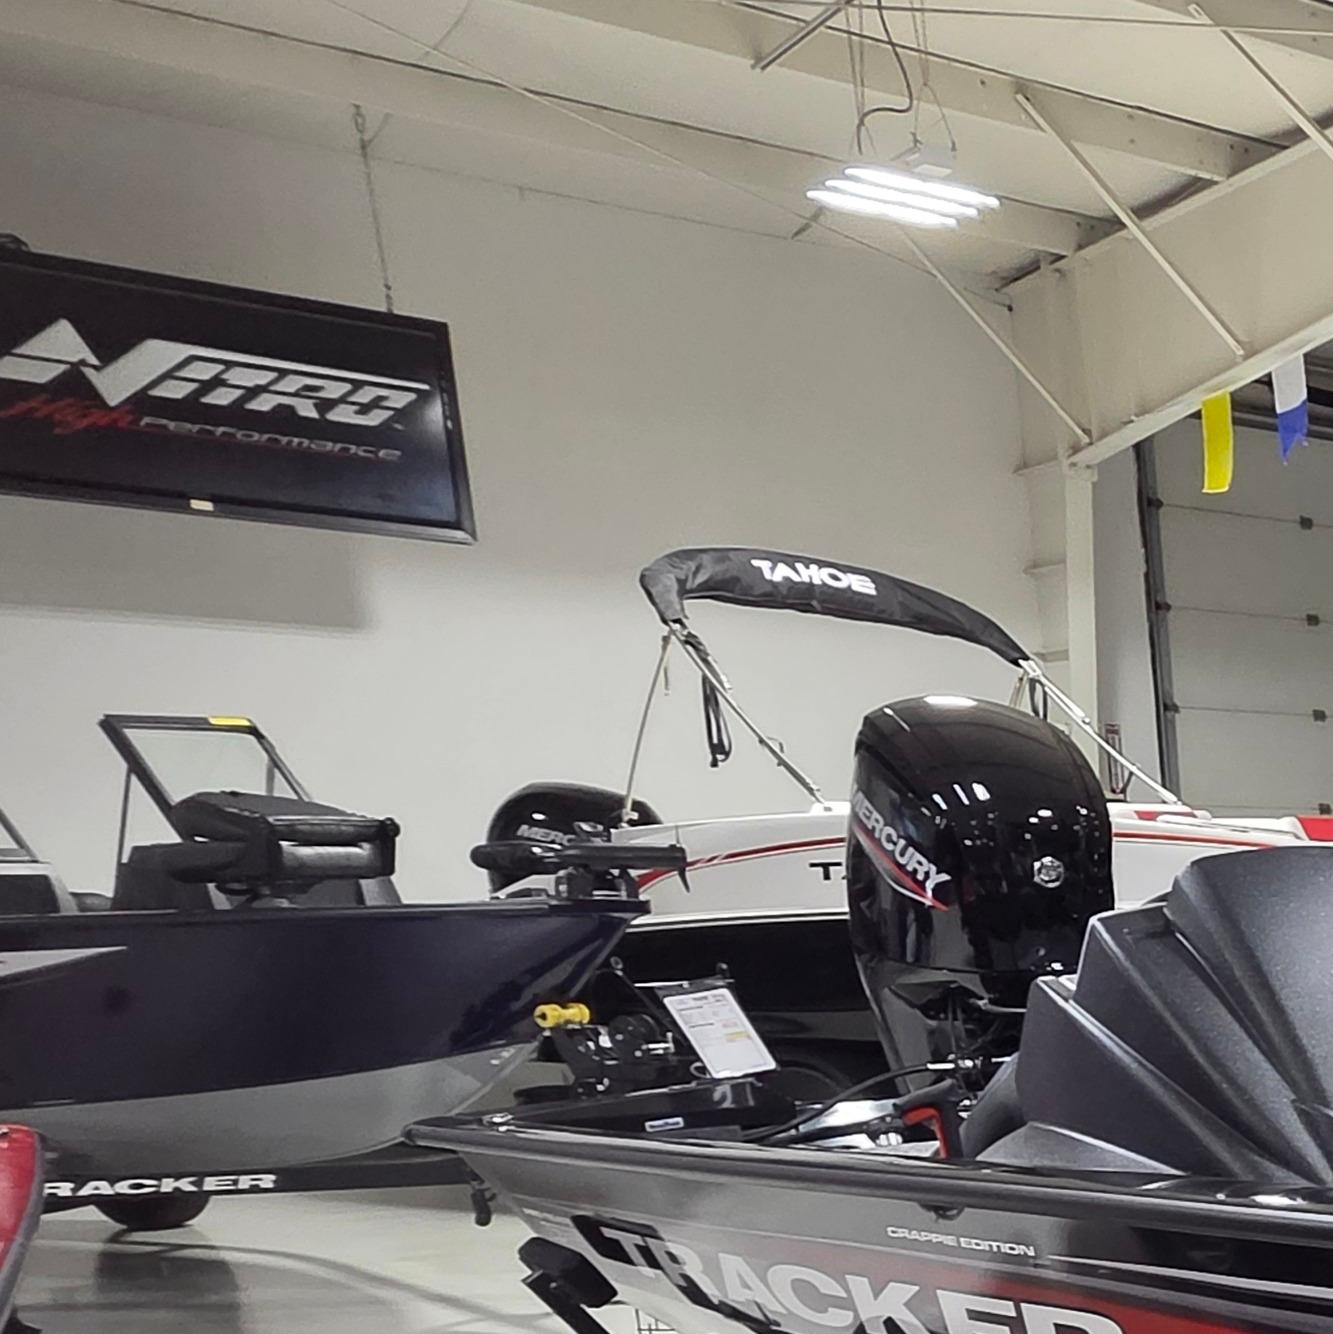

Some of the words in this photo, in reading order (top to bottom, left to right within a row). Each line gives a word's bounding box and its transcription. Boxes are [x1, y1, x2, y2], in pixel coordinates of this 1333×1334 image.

[0, 318, 430, 428] NITRO
[750, 559, 877, 595] TAHOE
[853, 791, 952, 899] MERCURY
[43, 1173, 277, 1197] RACKER
[886, 1226, 958, 1247] CRAPPIE
[959, 1237, 1036, 1256] EDITION
